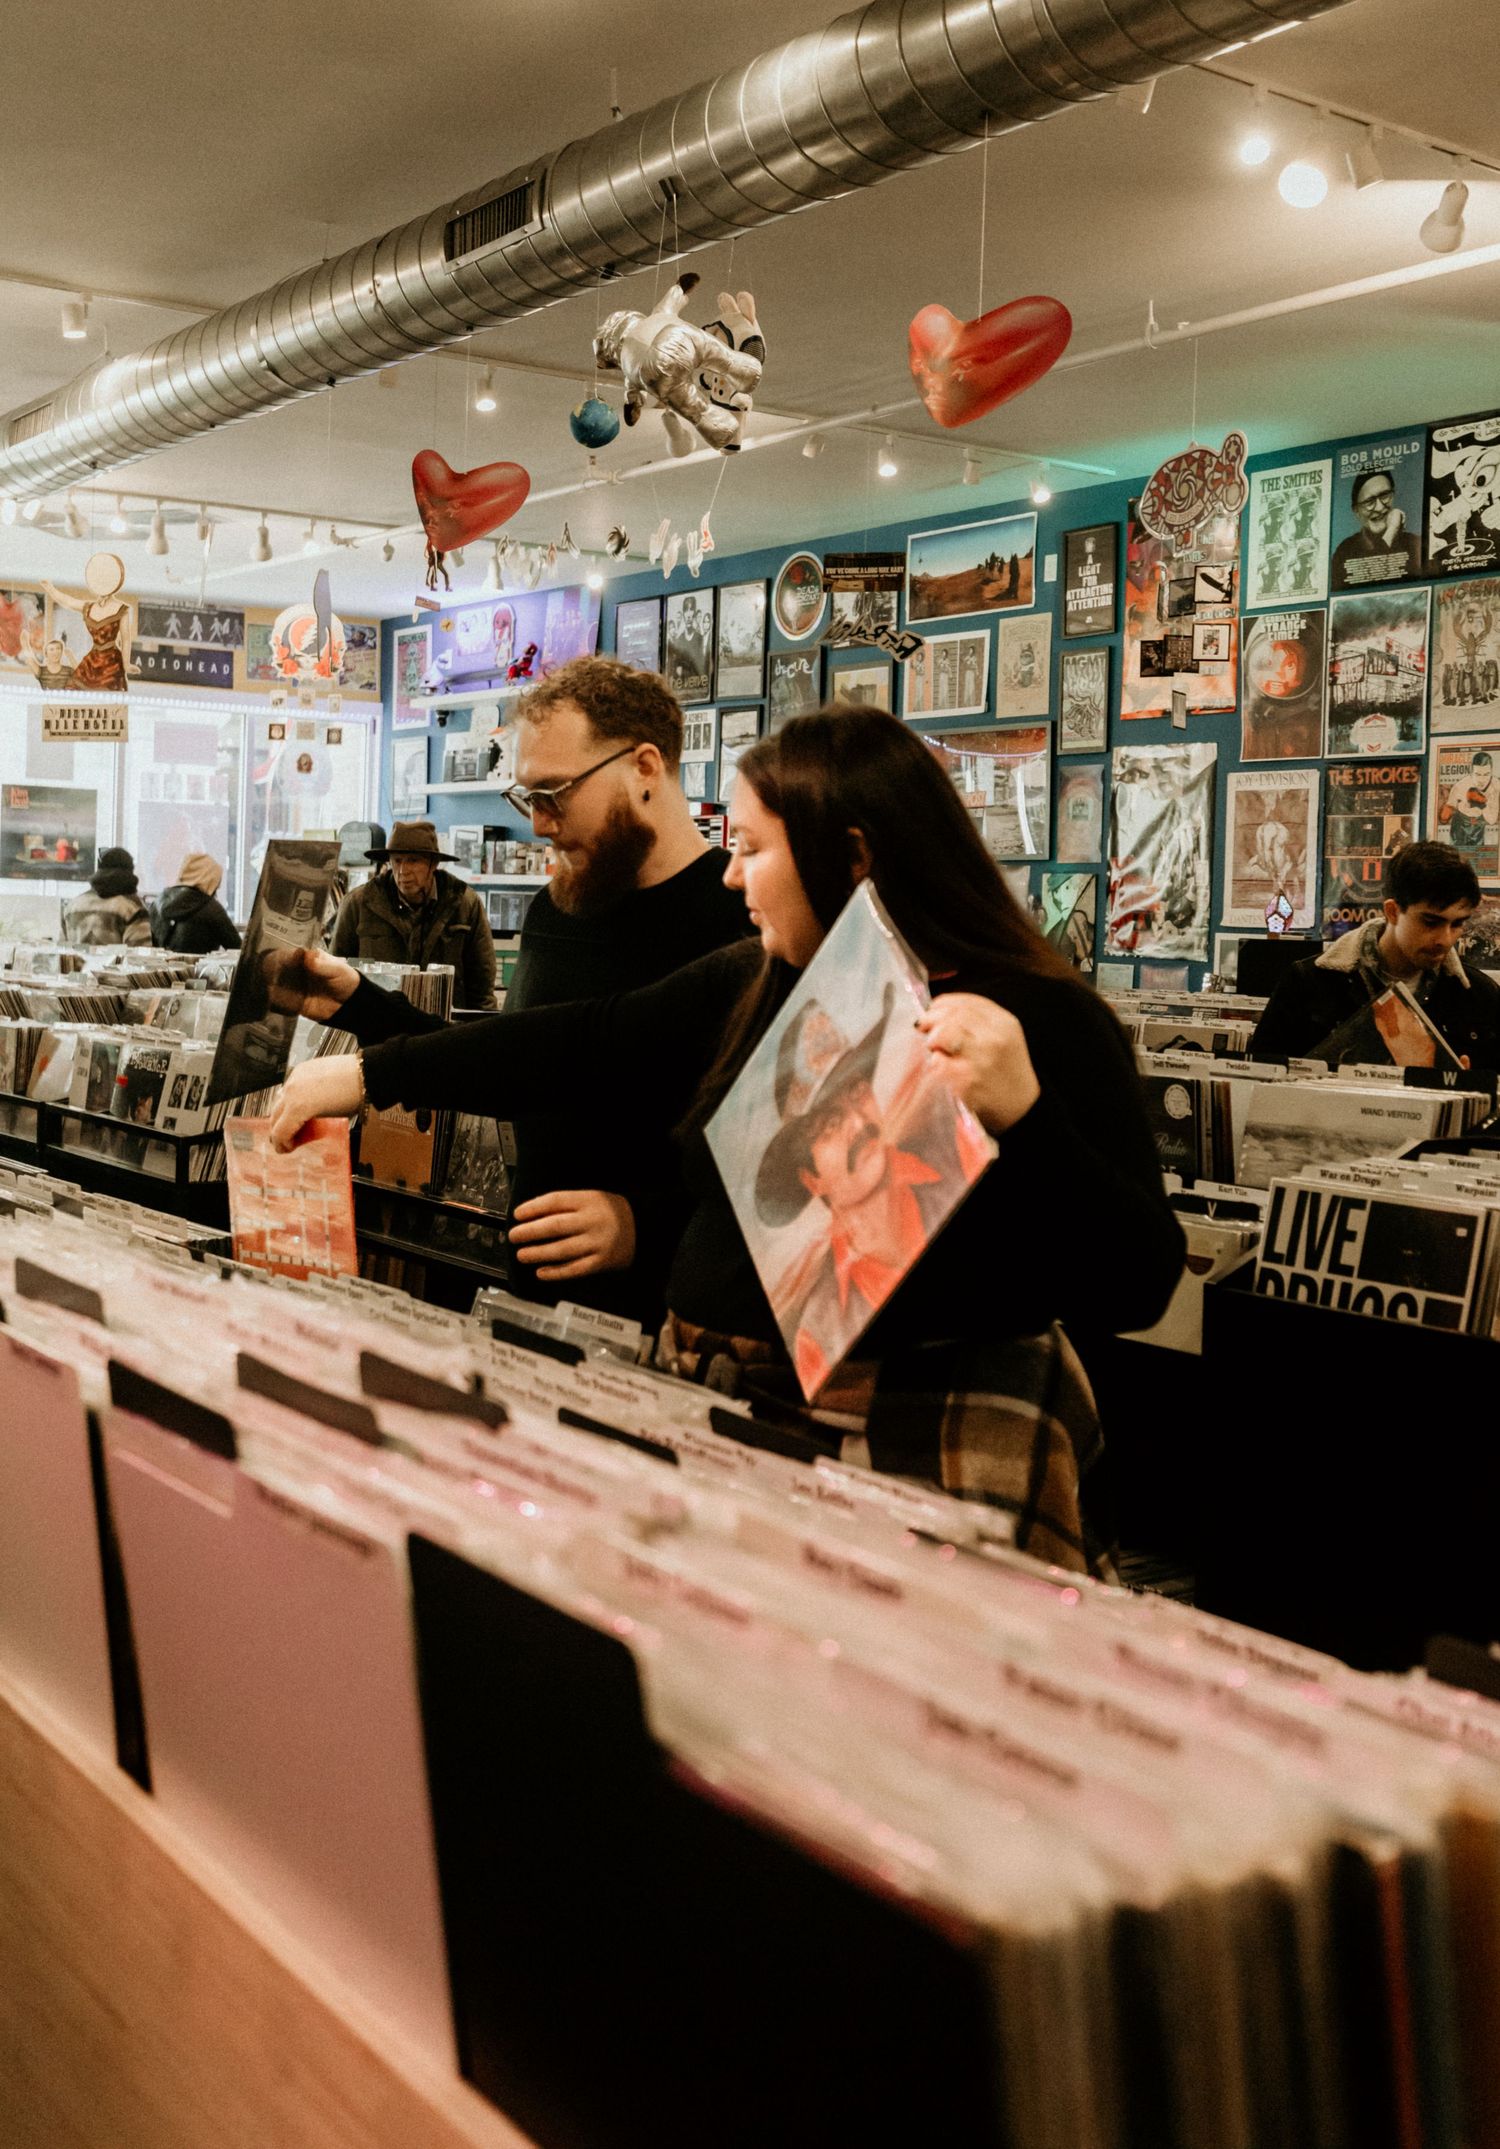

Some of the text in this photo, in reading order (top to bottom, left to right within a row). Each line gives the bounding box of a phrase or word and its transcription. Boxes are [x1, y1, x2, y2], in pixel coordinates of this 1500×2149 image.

[1341, 441, 1420, 465] BOB MOULD
[1341, 463, 1362, 474] SOLO
[1364, 456, 1403, 470] ELECTRIC
[1260, 477, 1281, 493] THE
[1282, 469, 1323, 490] SMITHS
[1087, 553, 1094, 565] A
[1078, 563, 1101, 577] LIGHT
[1082, 575, 1098, 588] FOR
[1066, 582, 1113, 601] ATTRACTING
[1067, 594, 1113, 612] ATTENTION
[135, 655, 230, 676] ADIOHEAD
[60, 708, 107, 719] NEUTRAL
[44, 719, 124, 730] MILK HOTEL
[1328, 765, 1419, 786] THE STROKES
[1440, 764, 1471, 776] LEGION
[1236, 772, 1310, 790] JOY DIVISION
[1226, 1062, 1250, 1072] Twiddle
[1354, 1069, 1401, 1080] The Walkme
[1443, 1071, 1457, 1086] W
[1361, 1107, 1422, 1121] WAND VERTIGO
[1448, 1158, 1480, 1170] Weezer
[1320, 1168, 1381, 1187] War on Drugs
[1218, 1185, 1248, 1196] Kurt Vile
[1456, 1183, 1496, 1198] Warpaint
[1207, 1200, 1218, 1218] V
[1262, 1186, 1368, 1278] LIVE
